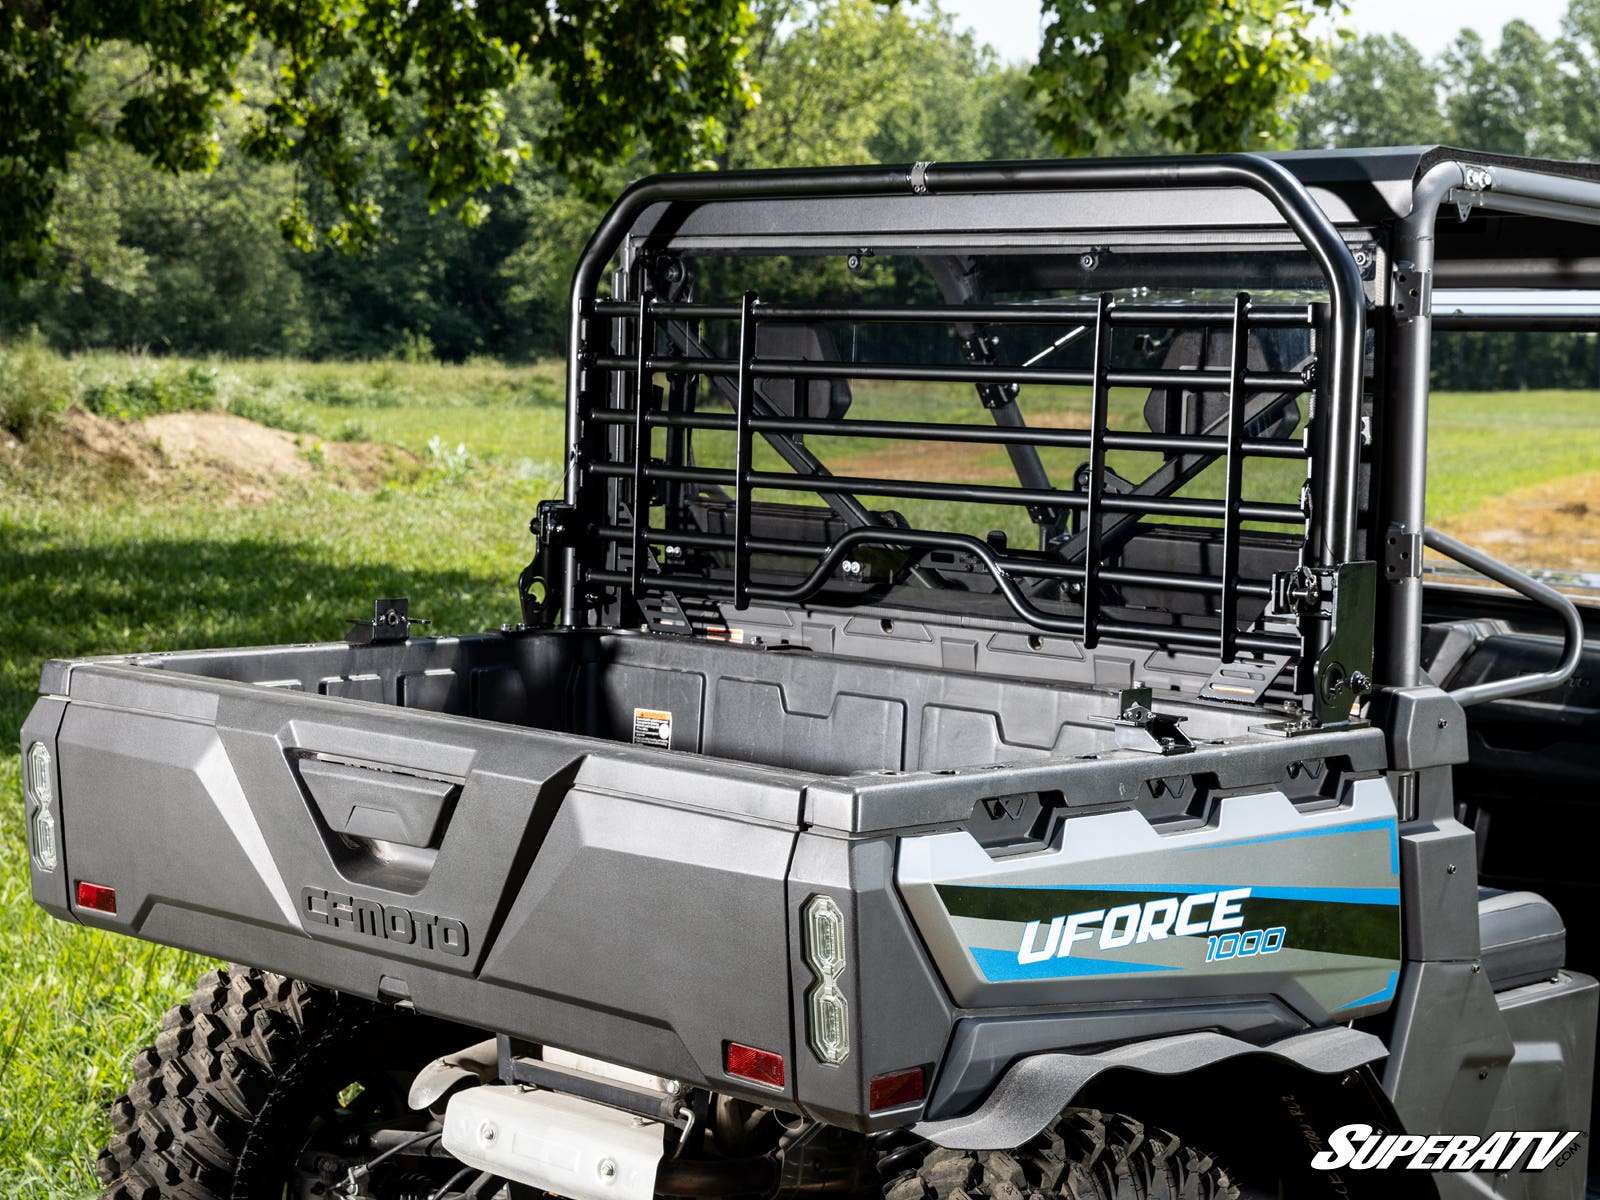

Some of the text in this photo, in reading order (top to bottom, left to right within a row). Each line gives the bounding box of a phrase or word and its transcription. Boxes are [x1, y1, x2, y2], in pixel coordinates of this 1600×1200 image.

[301, 886, 469, 957] CFMOTO
[1017, 887, 1251, 965] UFORCE
[1205, 927, 1286, 963] 1000
